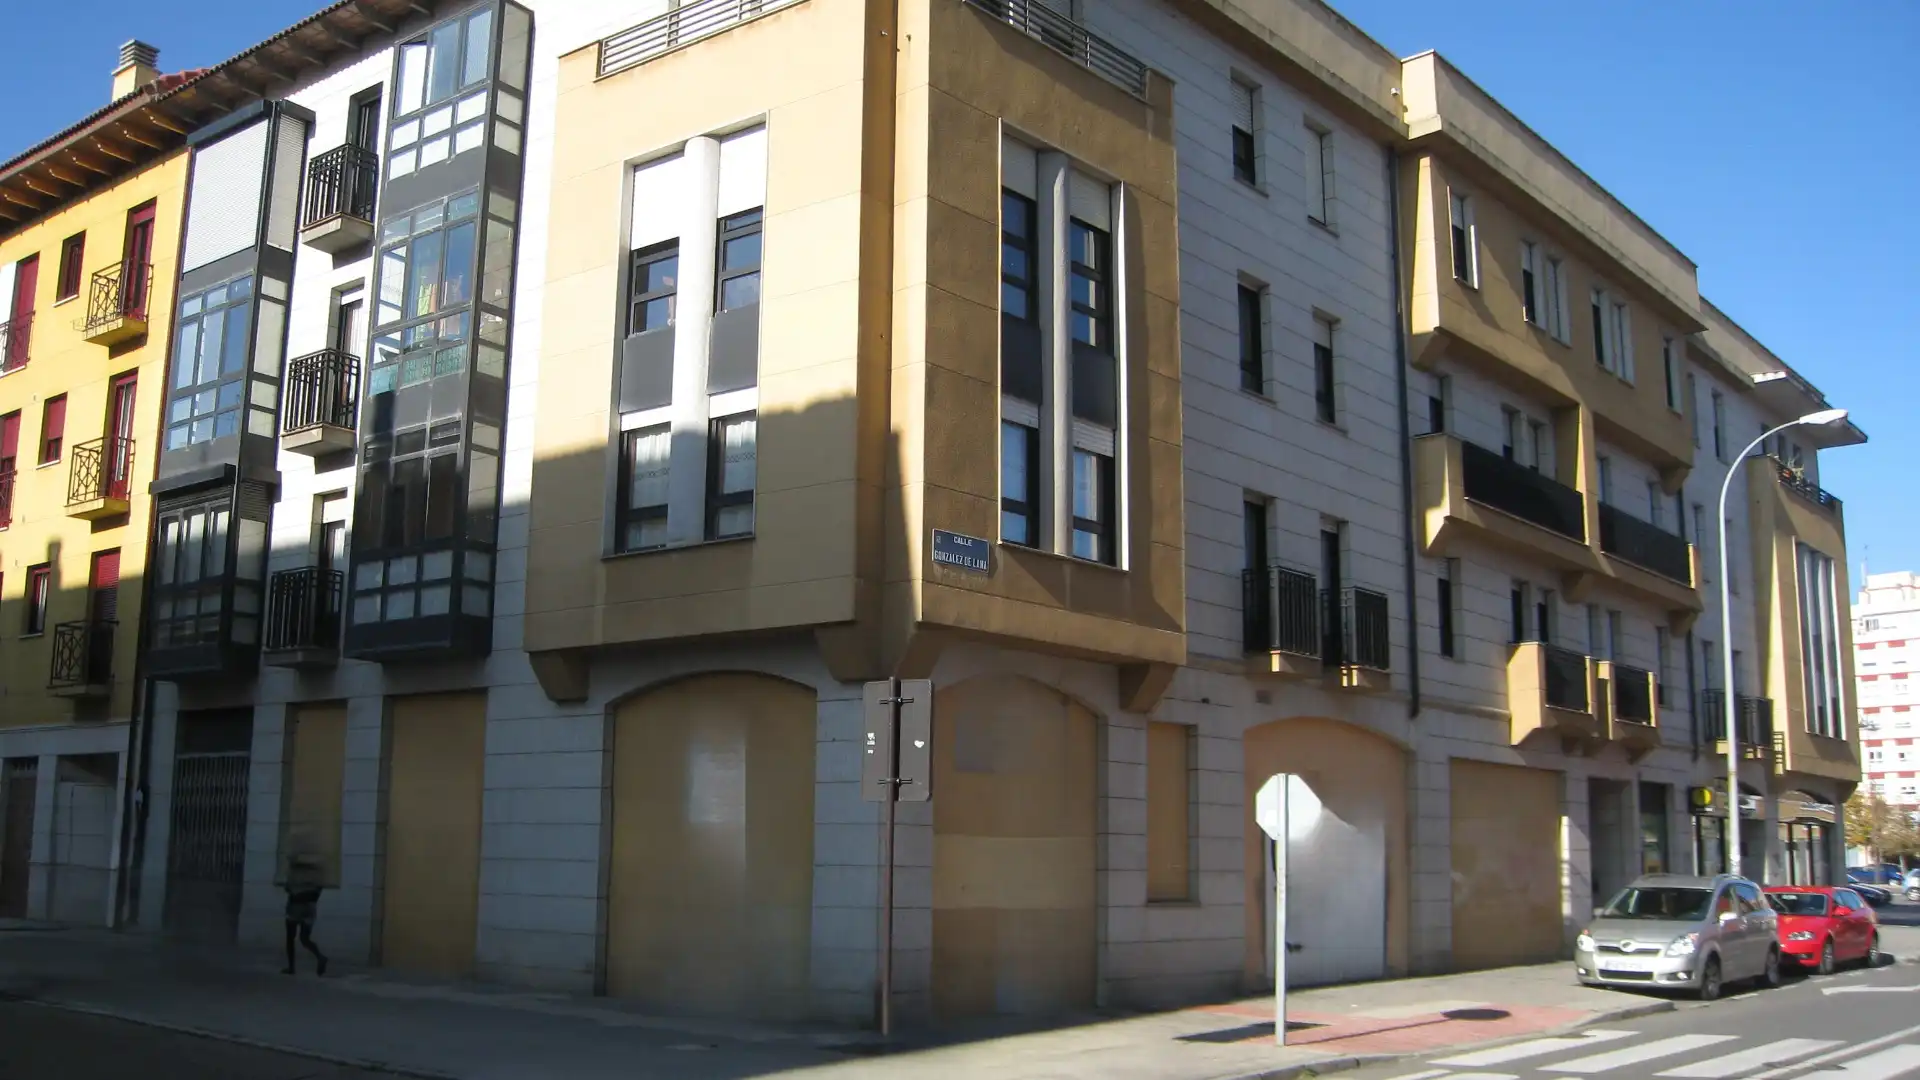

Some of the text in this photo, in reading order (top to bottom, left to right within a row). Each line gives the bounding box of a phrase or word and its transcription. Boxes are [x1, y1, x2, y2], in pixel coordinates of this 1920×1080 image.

[953, 536, 973, 547] CALLE
[934, 550, 963, 565] GONZALEZ
[964, 556, 972, 567] DE
